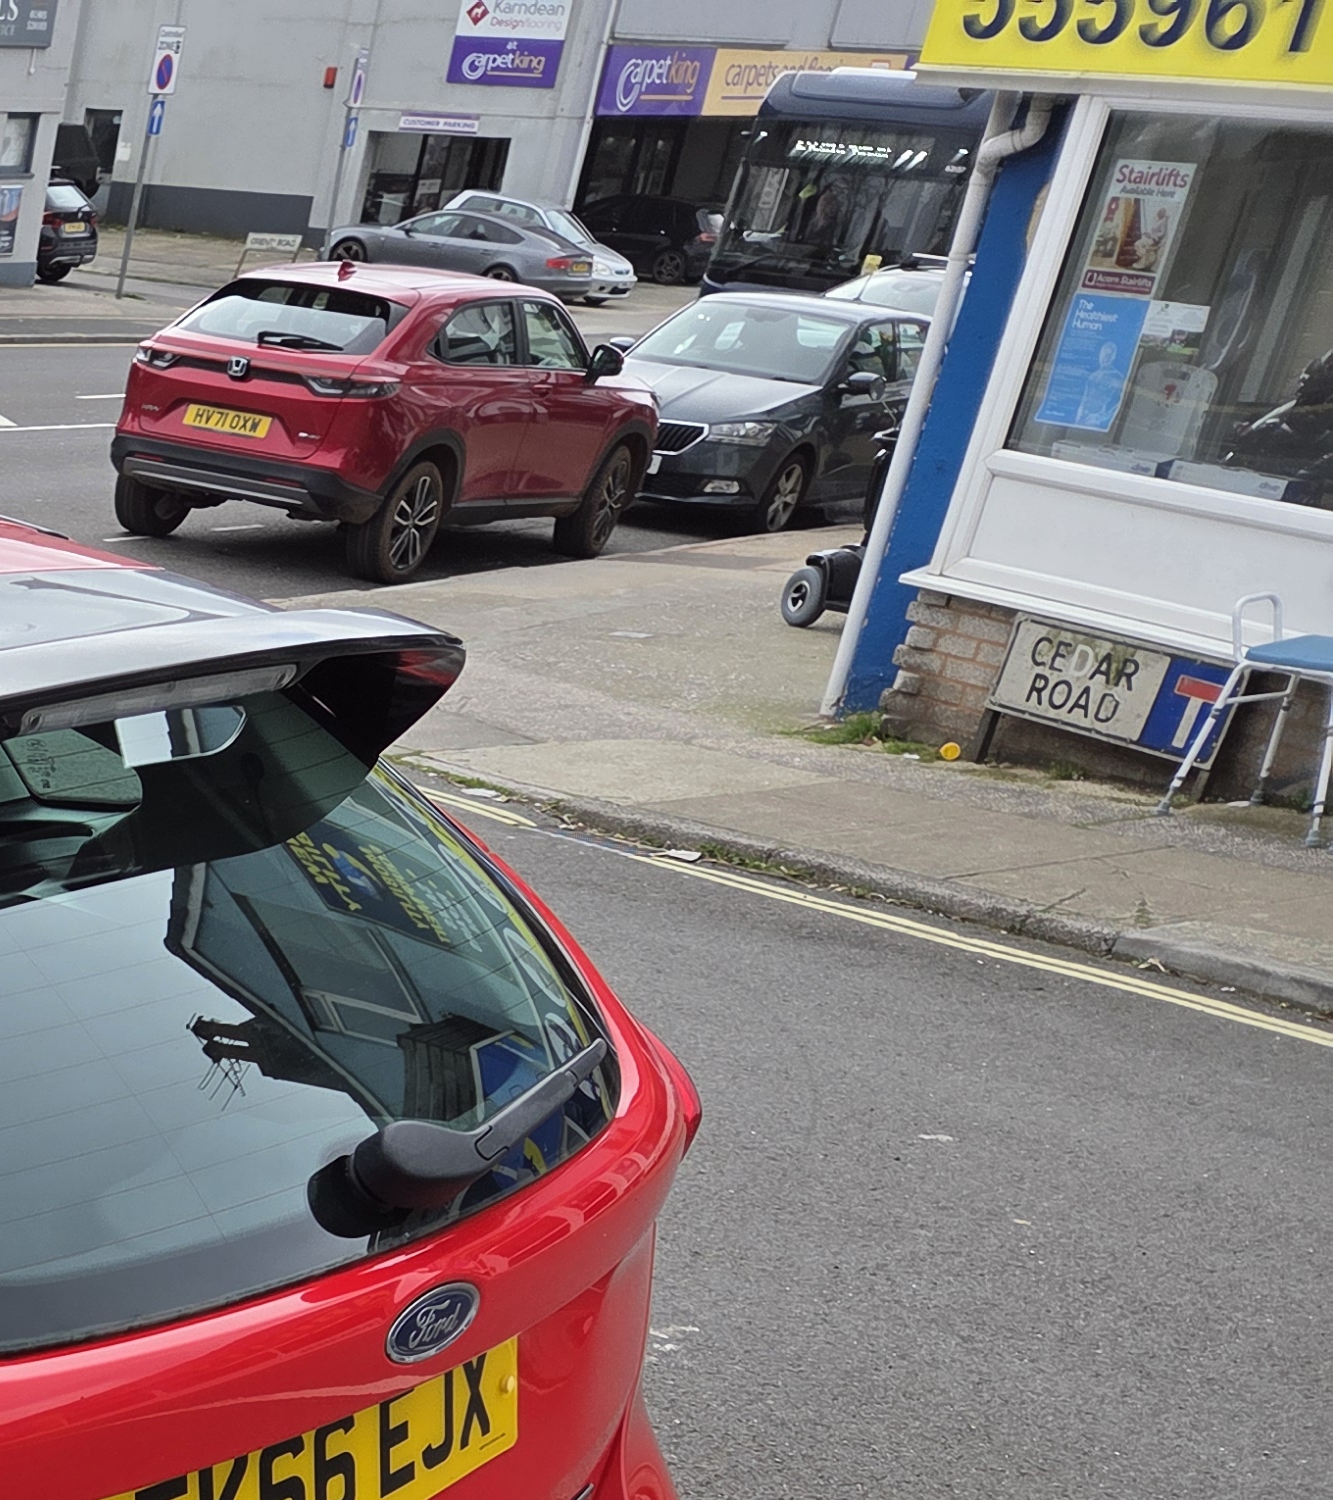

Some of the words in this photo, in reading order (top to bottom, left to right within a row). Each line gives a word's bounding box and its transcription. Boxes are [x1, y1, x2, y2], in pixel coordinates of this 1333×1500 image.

[493, 0, 565, 16] Karndean
[506, 41, 518, 50] at
[403, 119, 440, 127] CUSTOMER
[443, 121, 476, 129] PARKING
[1116, 164, 1190, 188] Stairlifts
[1119, 185, 1155, 196] Available
[1079, 299, 1095, 310] The
[1075, 309, 1119, 323] Healthiest
[1072, 319, 1103, 331] Human
[193, 408, 229, 428] HV71
[229, 414, 262, 433] OXW
[1031, 636, 1140, 691] CEDAR
[1025, 673, 1120, 723] ROAD
[409, 1299, 461, 1348] Ford
[379, 1352, 491, 1499] EJX
